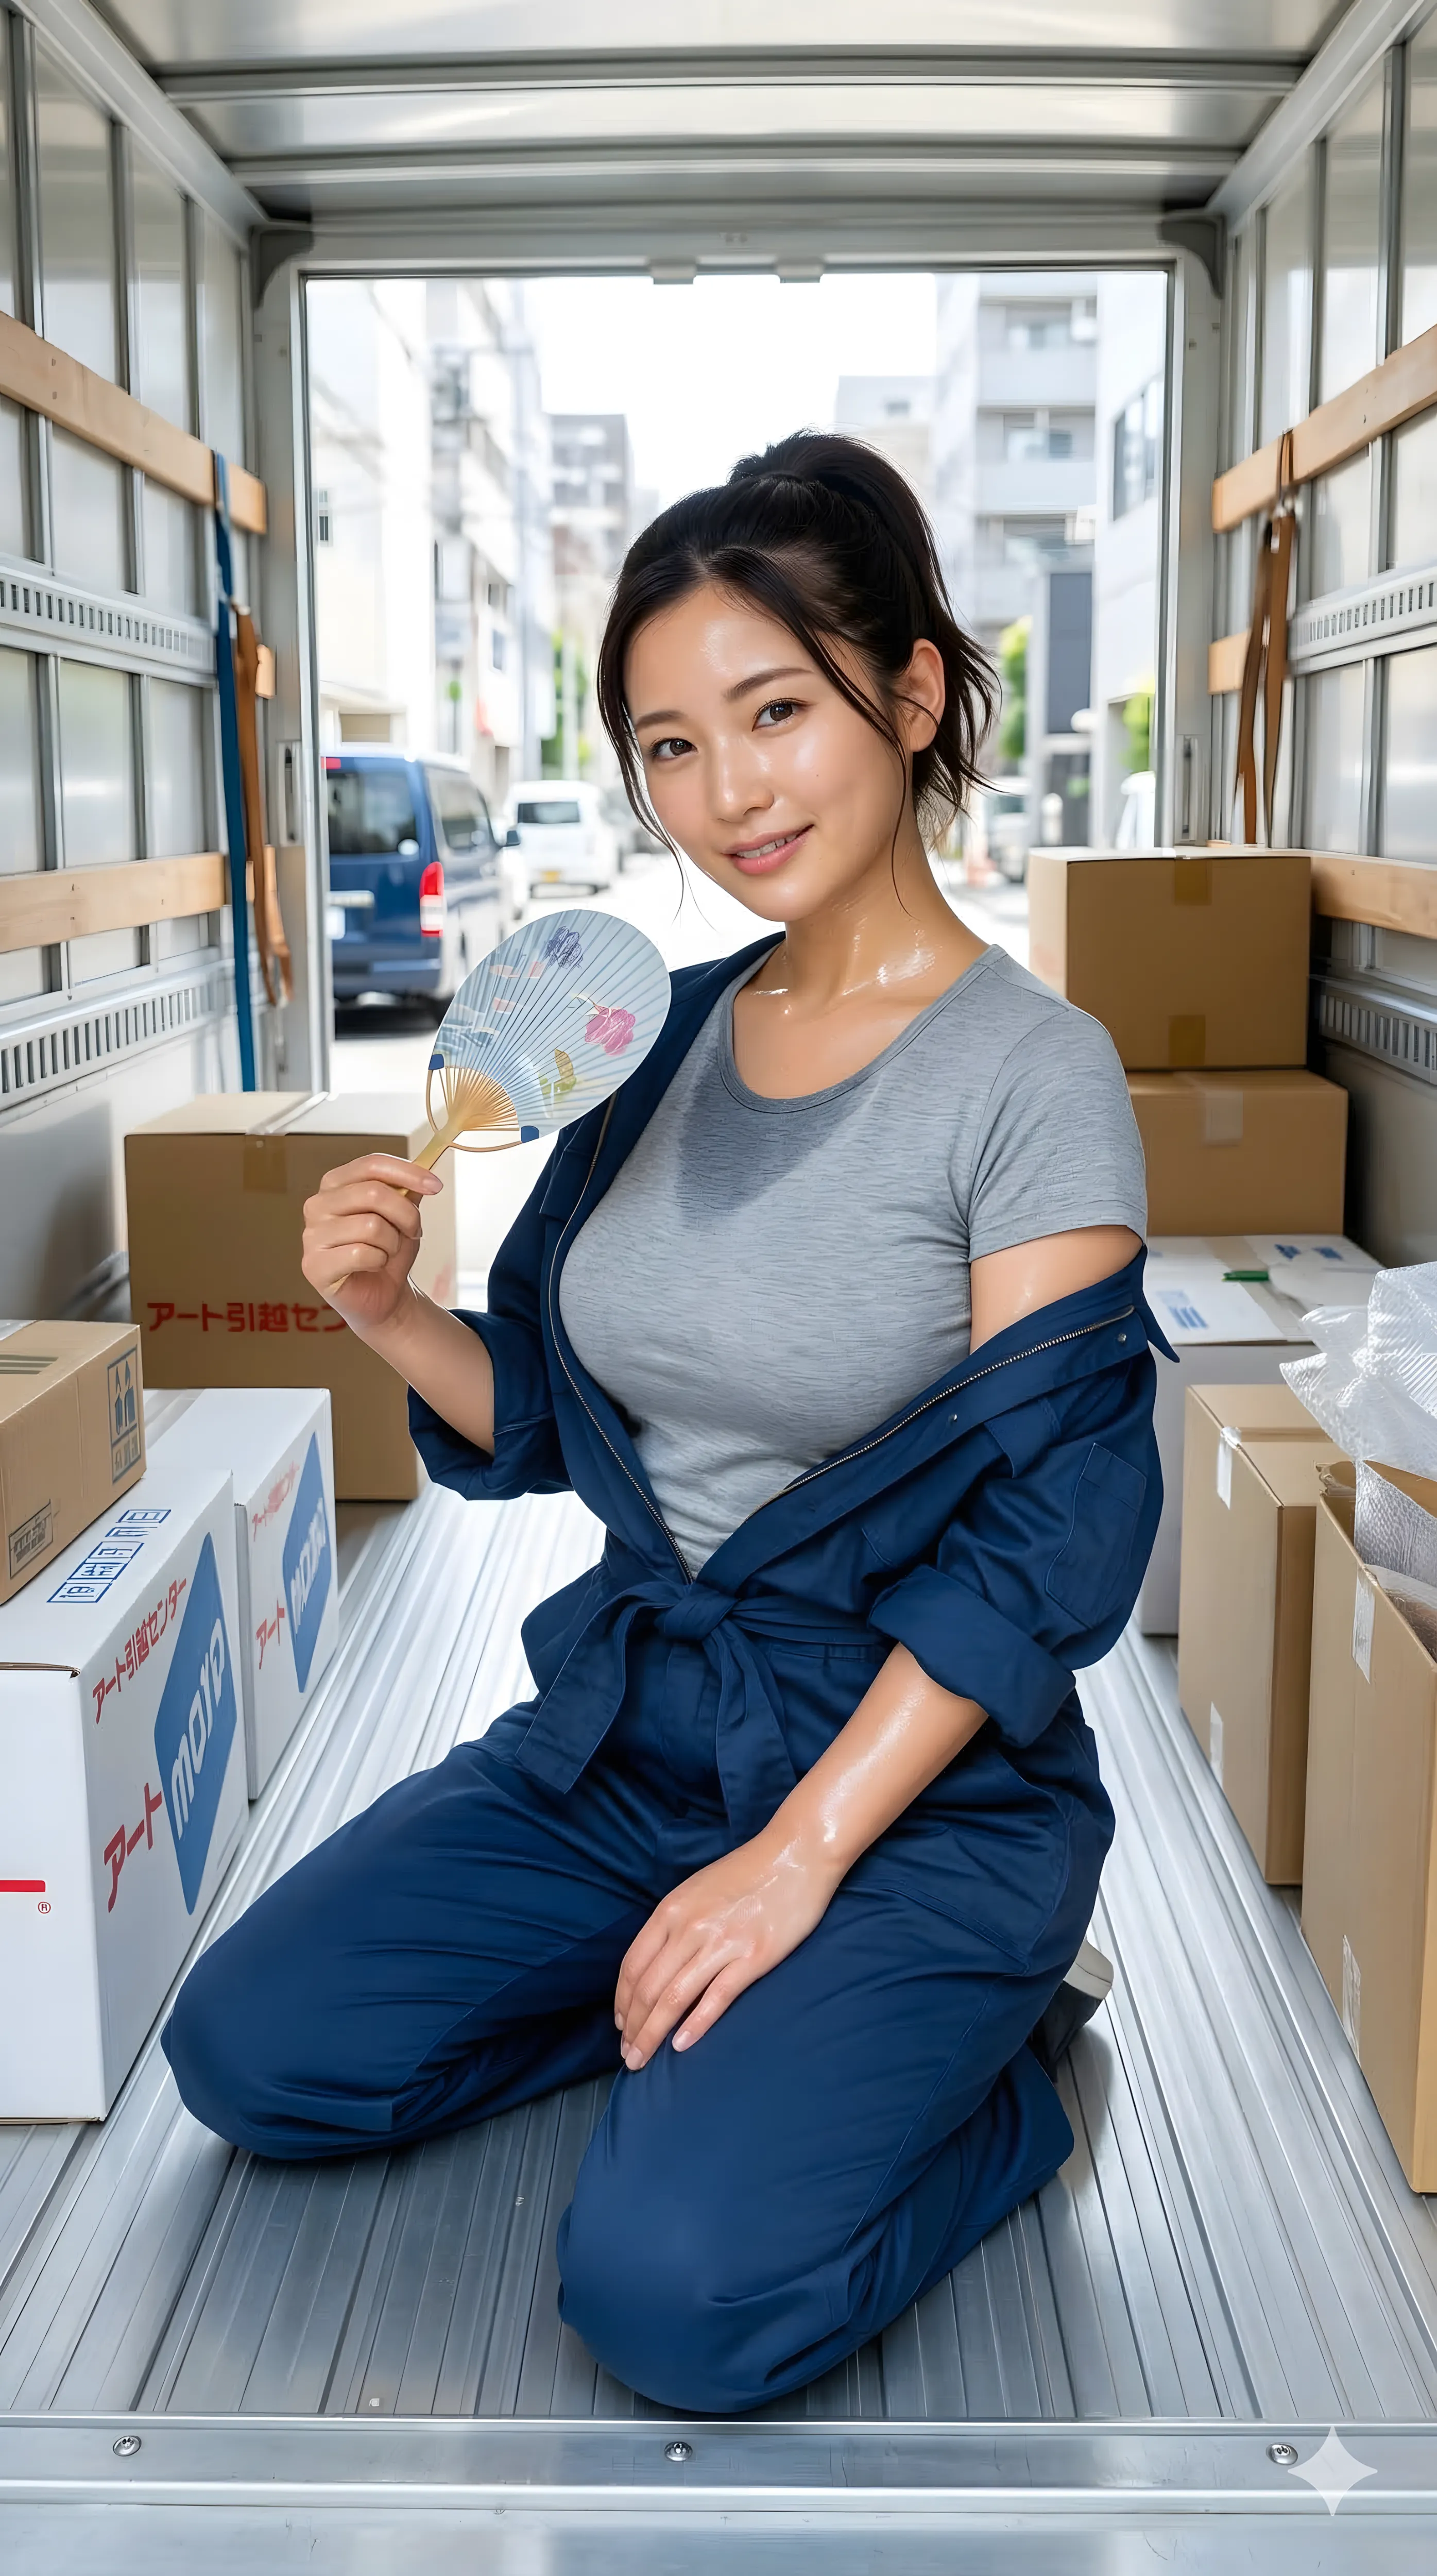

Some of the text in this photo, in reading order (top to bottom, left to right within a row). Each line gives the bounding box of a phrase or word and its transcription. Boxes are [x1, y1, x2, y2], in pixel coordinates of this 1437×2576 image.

[93, 1578, 186, 1724] アート引越センター
[104, 1783, 162, 1913] アート
